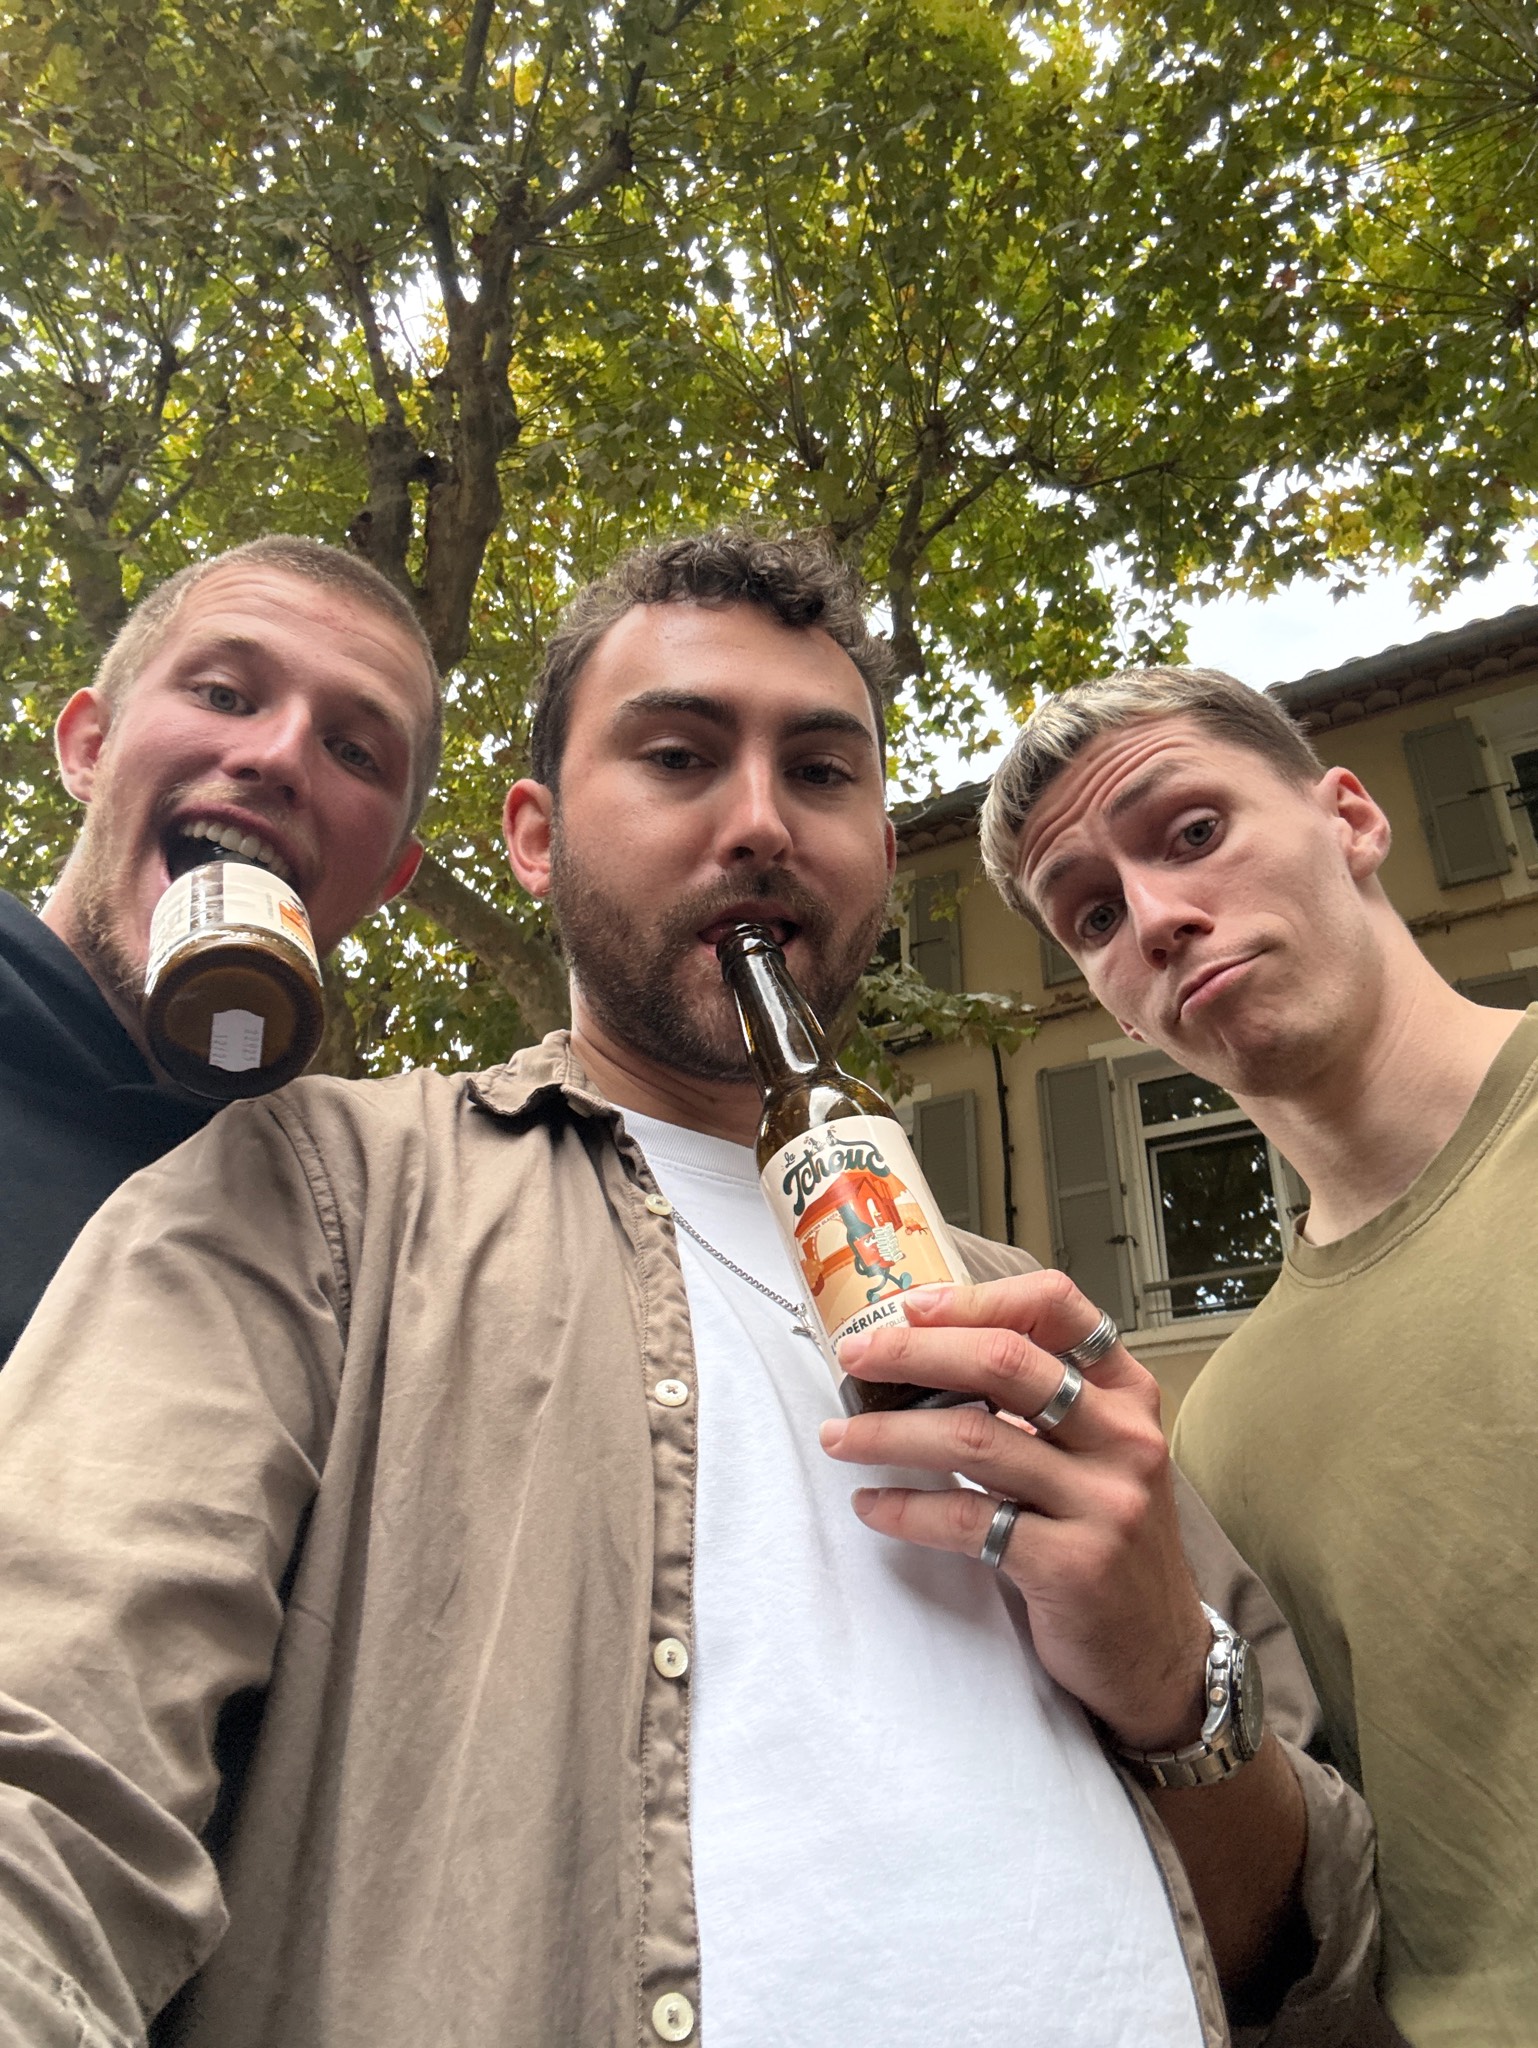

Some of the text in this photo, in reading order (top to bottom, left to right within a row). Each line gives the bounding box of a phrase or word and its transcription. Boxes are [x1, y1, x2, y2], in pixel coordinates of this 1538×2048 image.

[783, 1149, 891, 1216] Tchouc
[831, 1302, 898, 1356] L'PÉRIALE
[885, 1315, 906, 1329] COLLO
